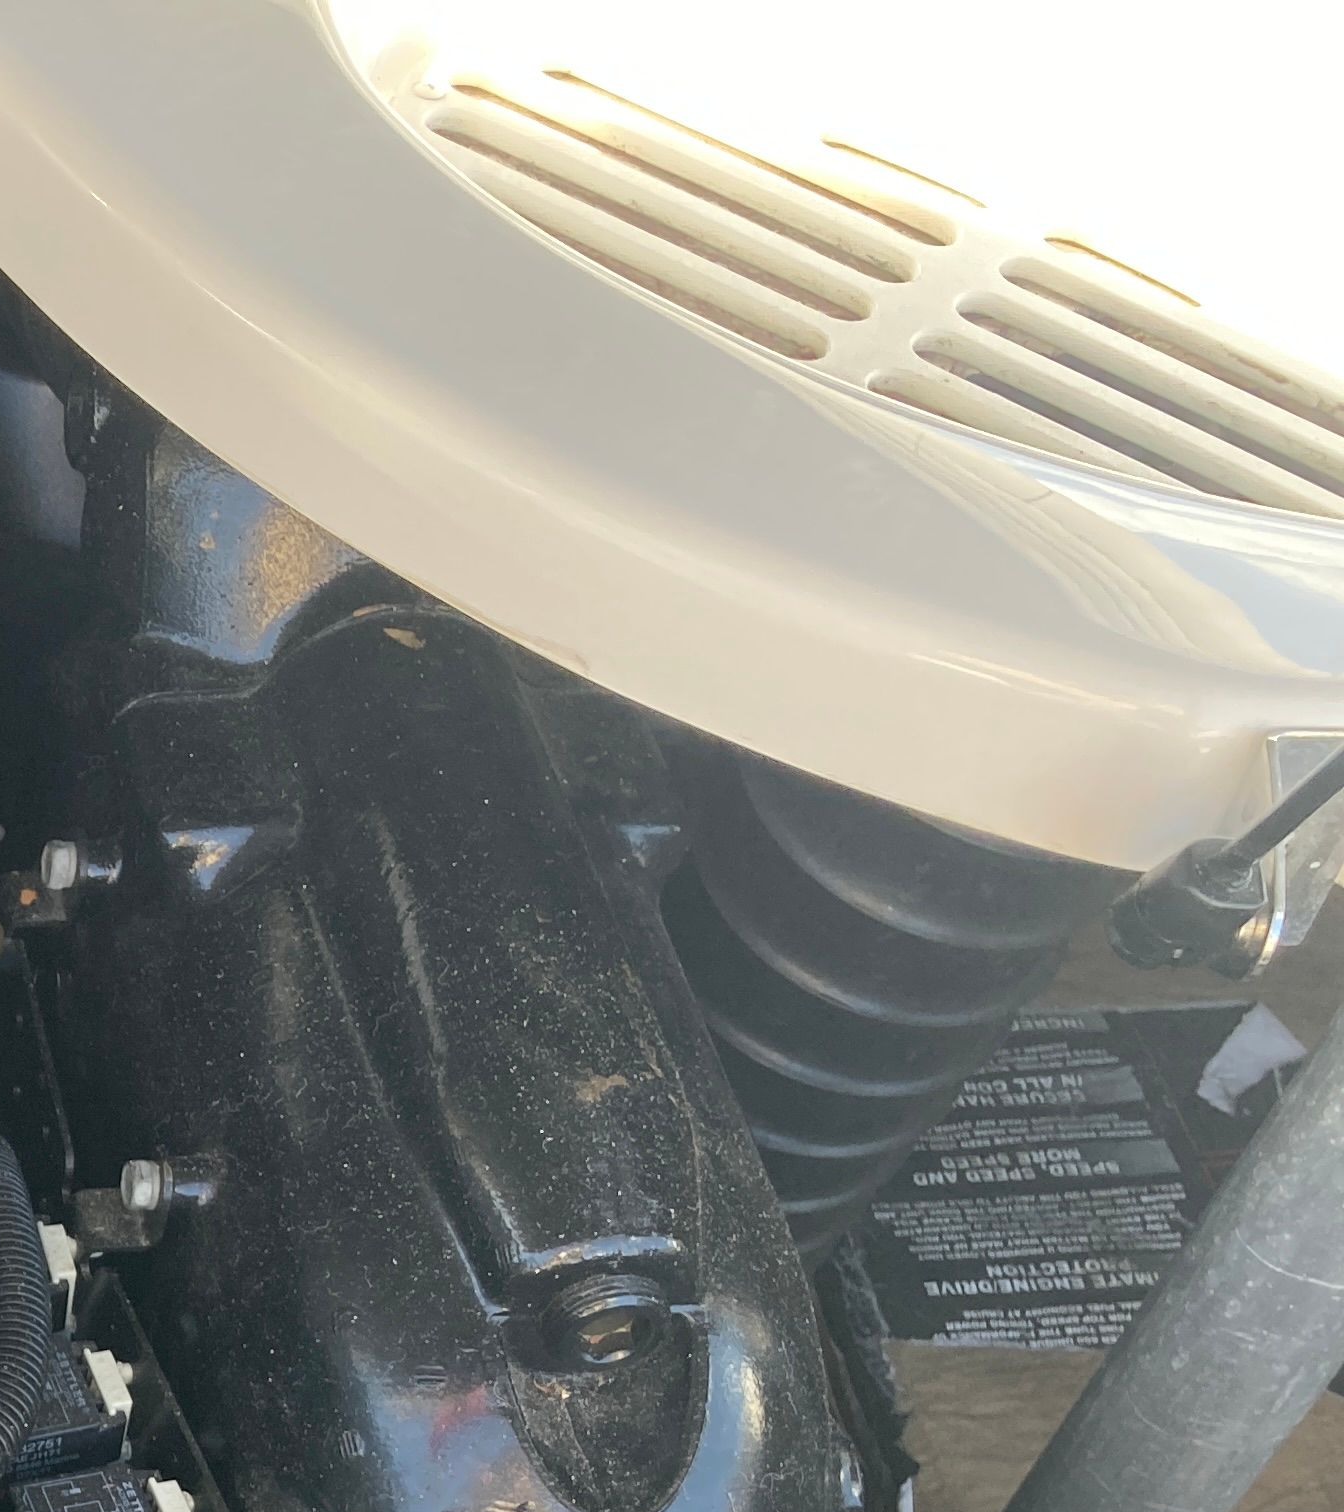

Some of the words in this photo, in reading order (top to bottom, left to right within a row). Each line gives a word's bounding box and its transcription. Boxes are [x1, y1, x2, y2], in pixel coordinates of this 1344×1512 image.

[940, 1151, 1011, 1170] SPEED
[1015, 1147, 1082, 1166] MORE
[912, 1170, 958, 1187] AND
[965, 1167, 1037, 1184] SPEED
[986, 1257, 1133, 1279] PROTECTION
